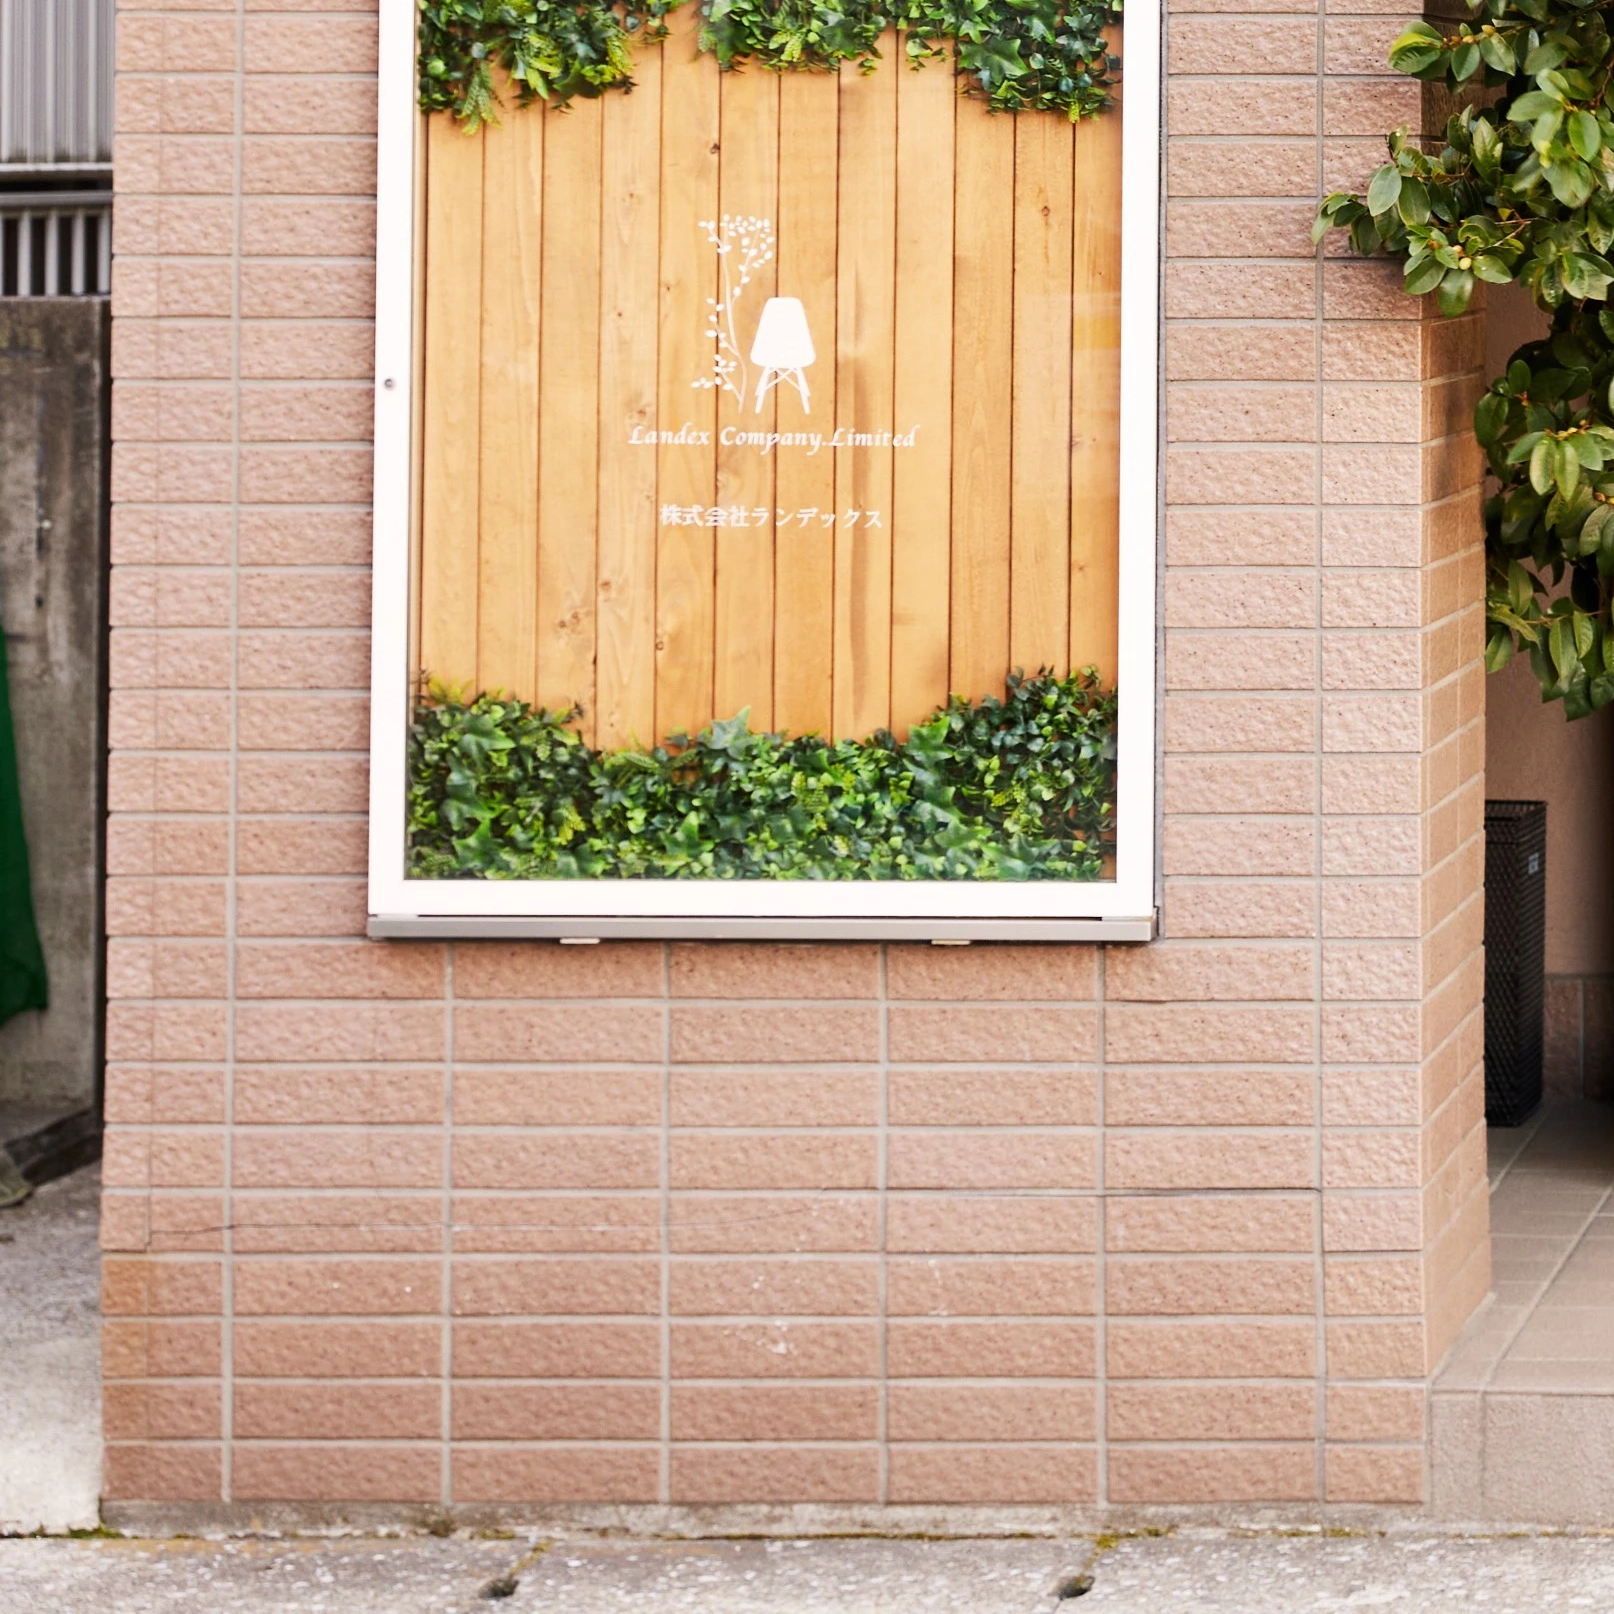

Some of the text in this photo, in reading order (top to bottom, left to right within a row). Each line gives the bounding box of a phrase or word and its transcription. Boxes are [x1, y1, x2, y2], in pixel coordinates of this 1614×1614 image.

[627, 422, 710, 447] Landex
[659, 502, 883, 530] 株式会社ランデックス
